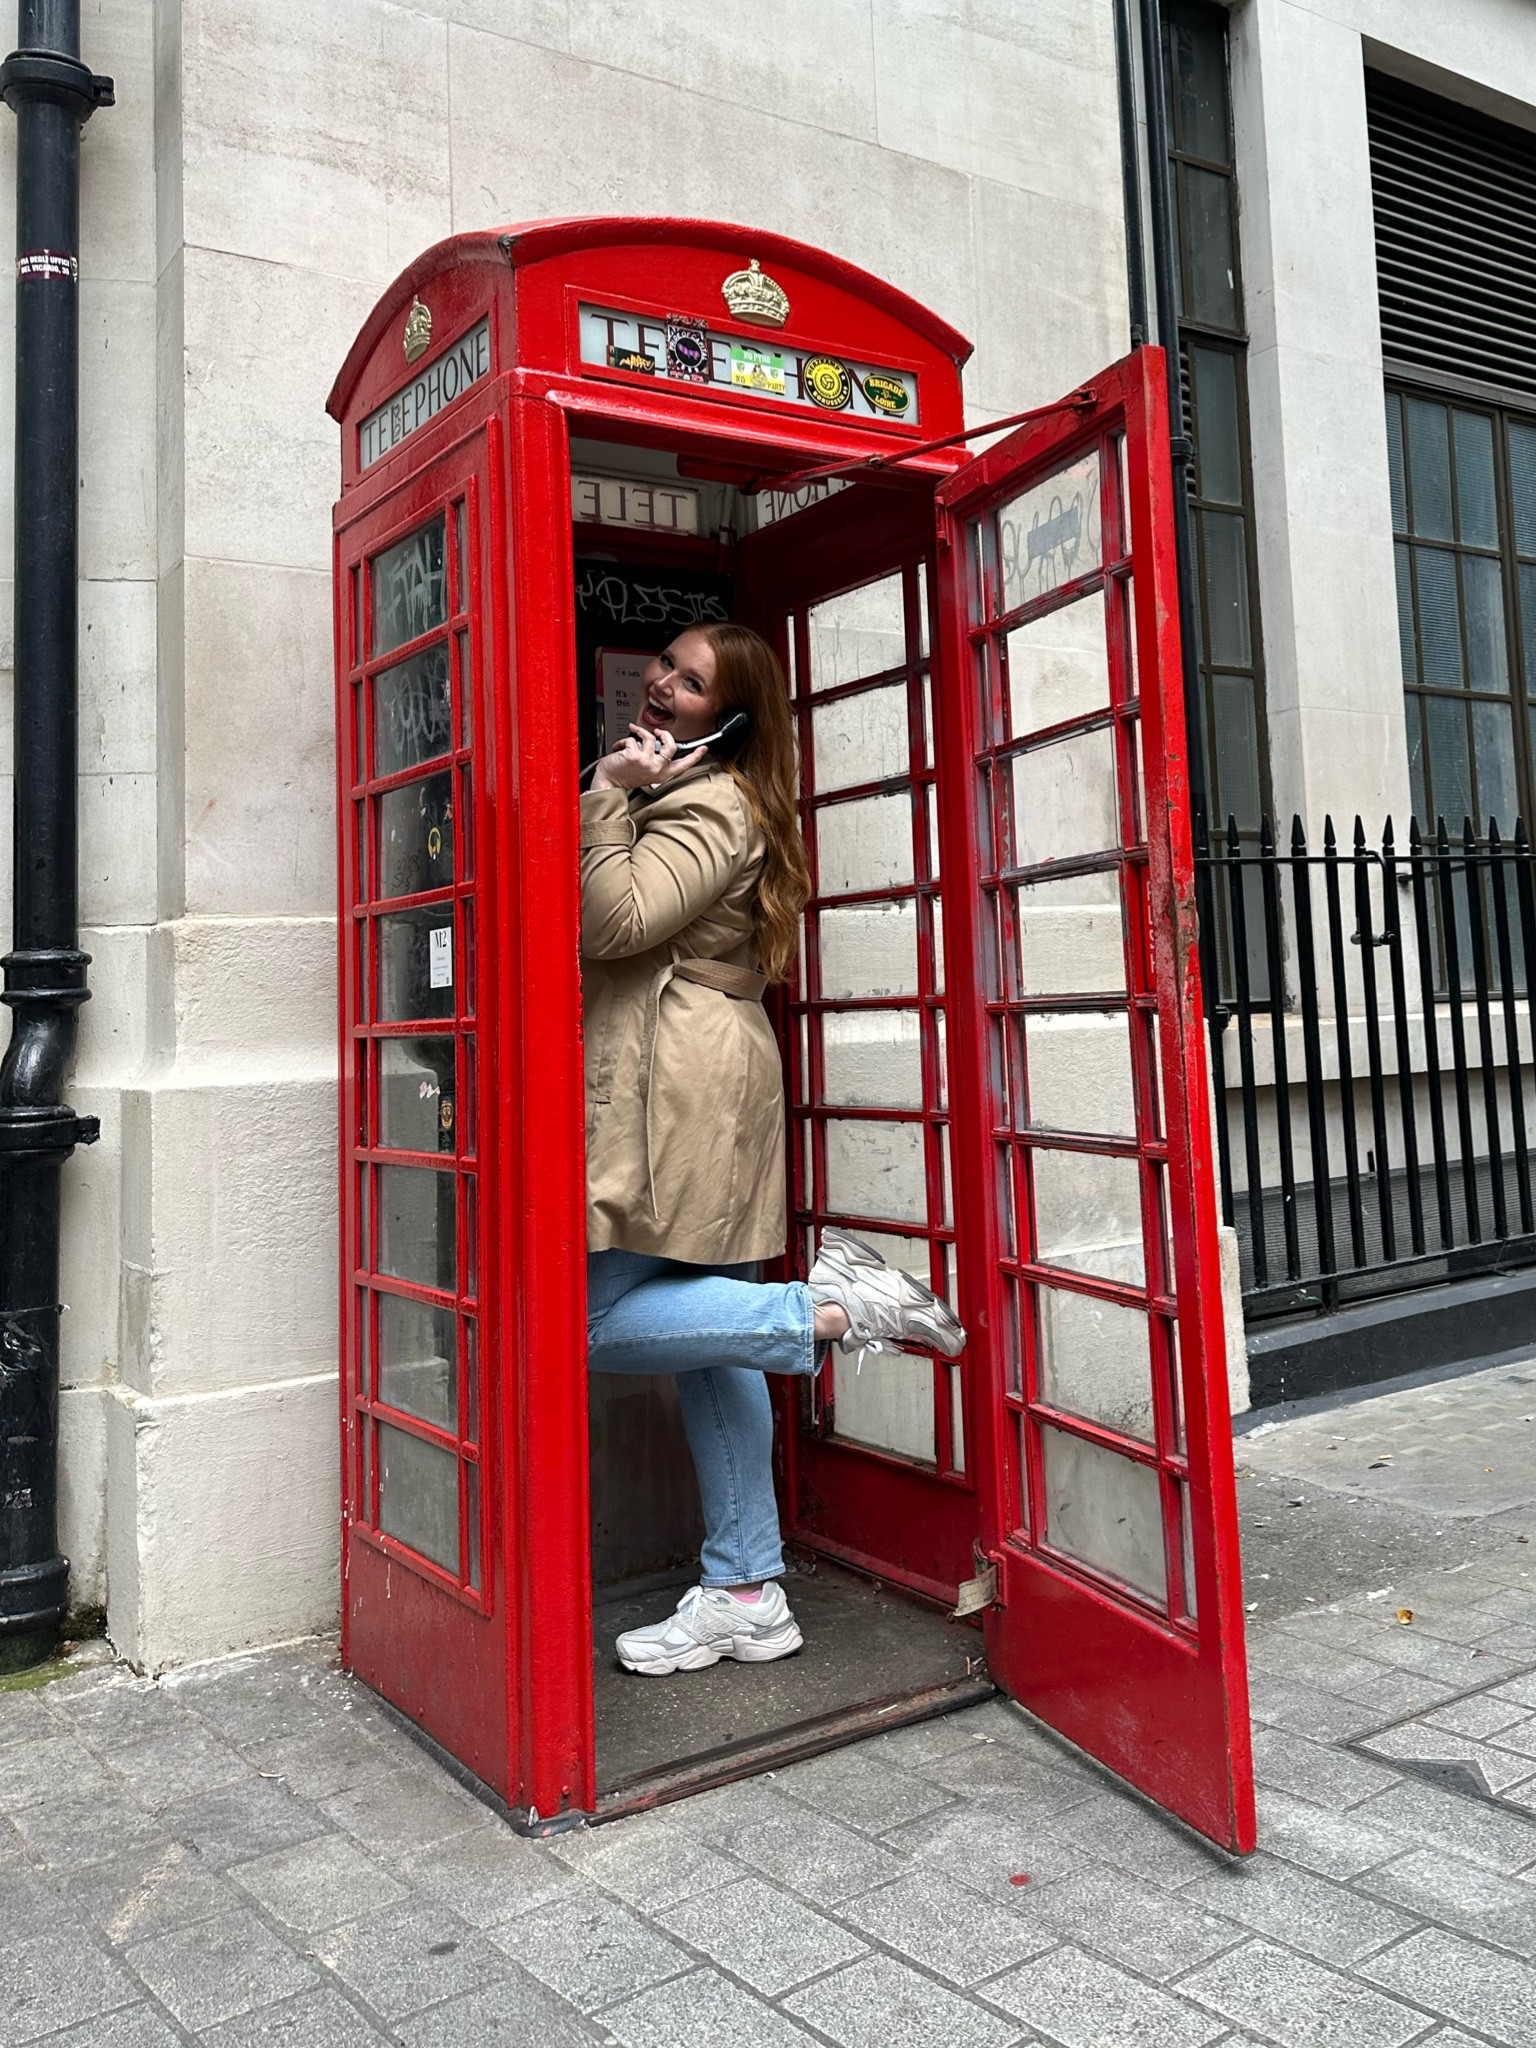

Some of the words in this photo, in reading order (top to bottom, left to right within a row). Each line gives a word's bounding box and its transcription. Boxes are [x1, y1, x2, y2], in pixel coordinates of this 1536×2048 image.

[30, 255, 48, 264] DEGLI
[50, 256, 69, 266] UFFICI
[735, 374, 746, 384] NO
[767, 381, 785, 391] PARTY
[869, 378, 905, 398] BRIGADE
[363, 328, 488, 463] TELEPHONE
[875, 394, 897, 409] LOIRE
